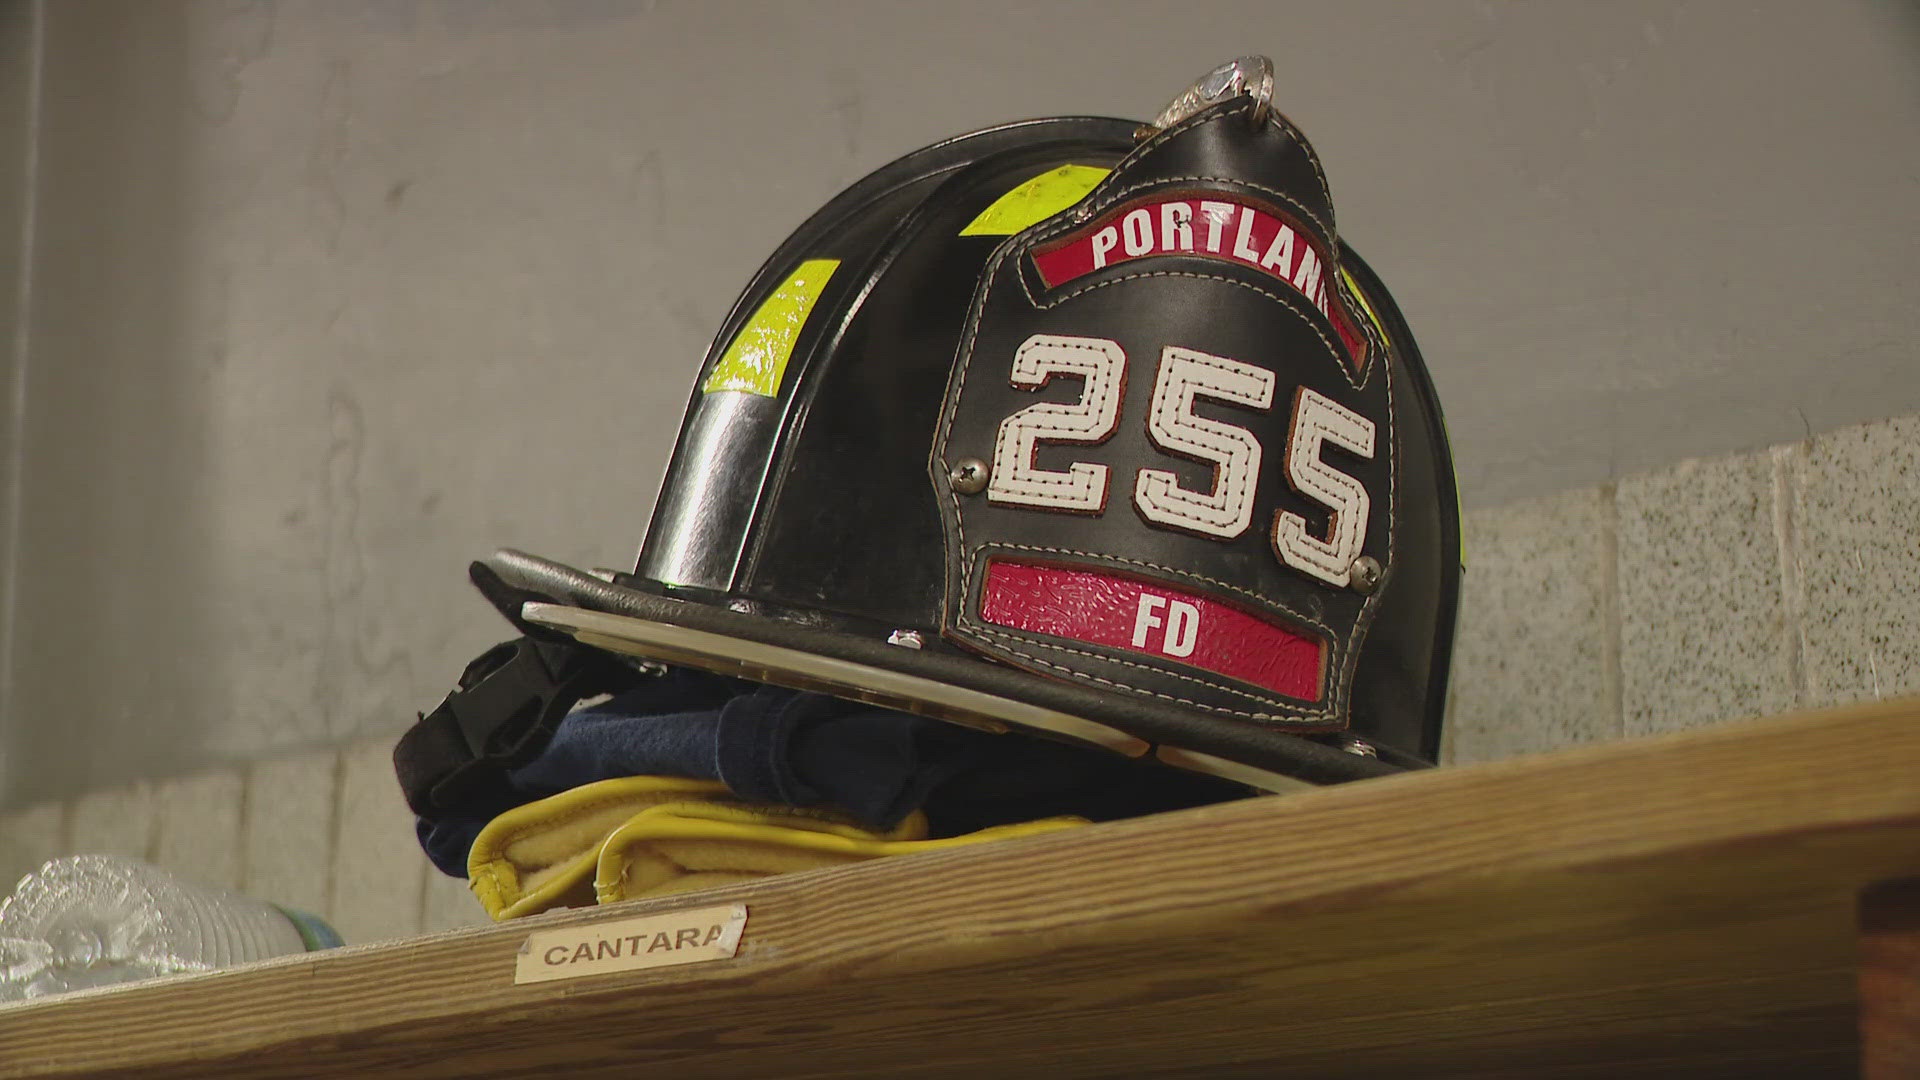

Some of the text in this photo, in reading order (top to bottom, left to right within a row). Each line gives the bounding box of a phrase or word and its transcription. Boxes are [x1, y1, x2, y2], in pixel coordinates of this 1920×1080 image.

[988, 334, 1376, 588] 255
[1132, 593, 1200, 658] FD
[543, 924, 724, 966] CANTARA
